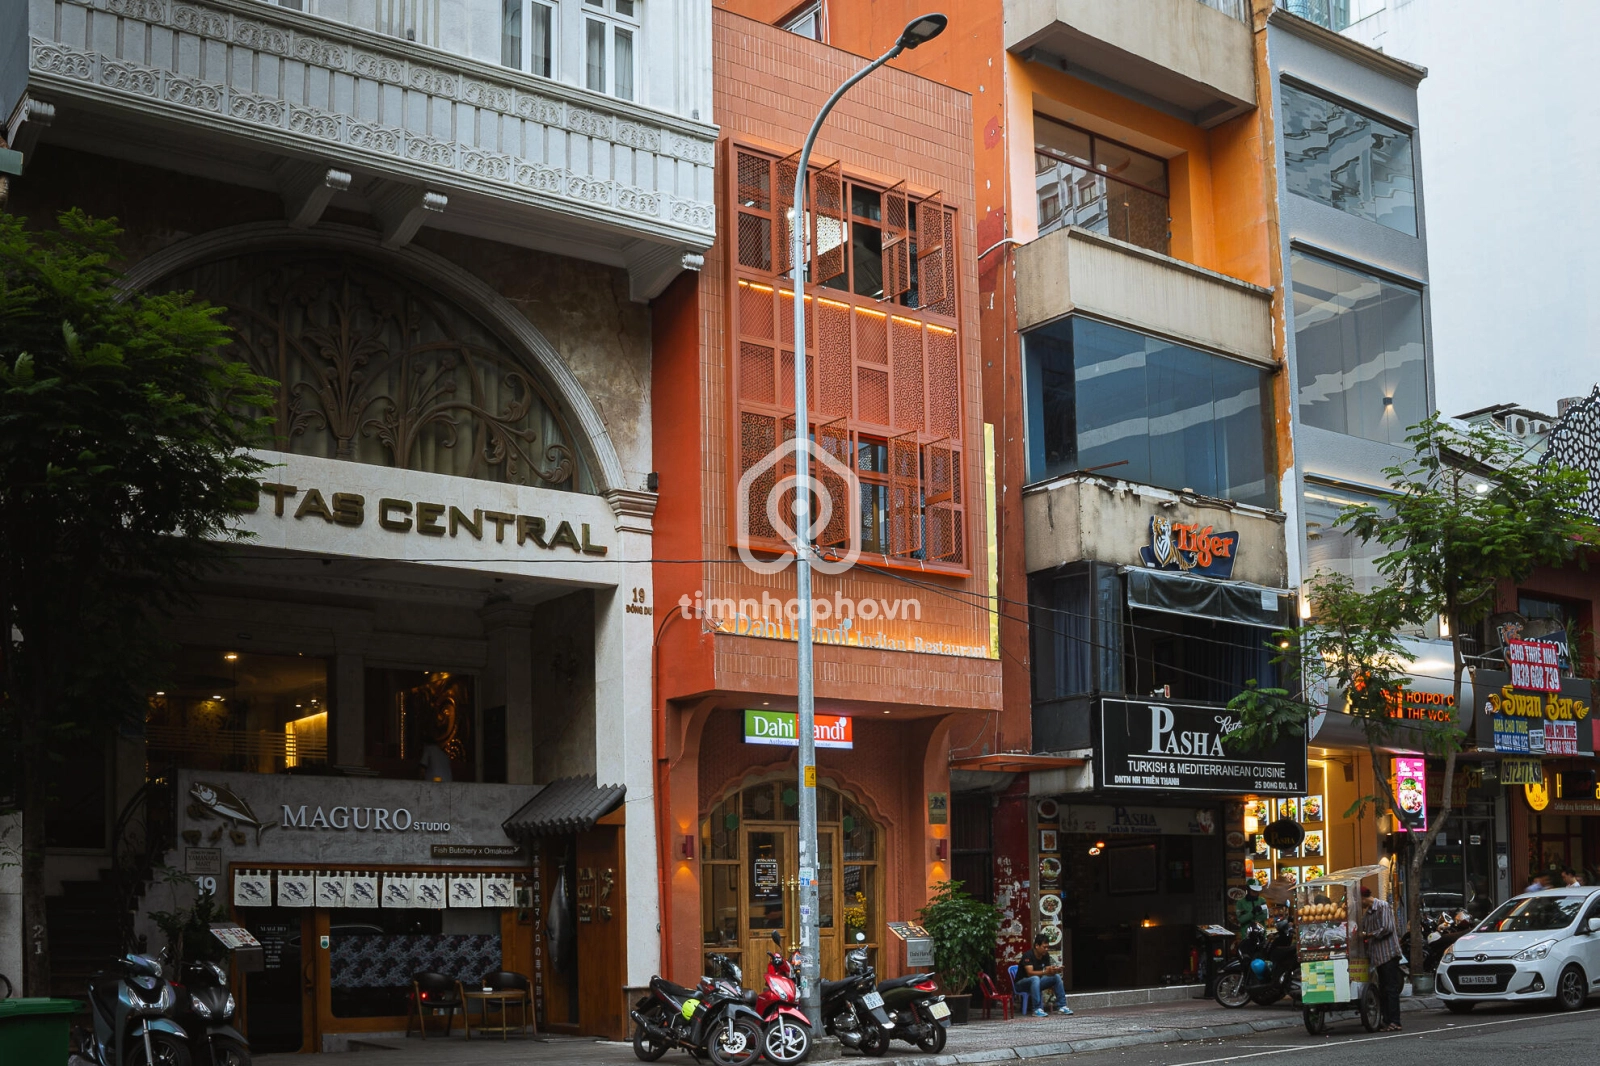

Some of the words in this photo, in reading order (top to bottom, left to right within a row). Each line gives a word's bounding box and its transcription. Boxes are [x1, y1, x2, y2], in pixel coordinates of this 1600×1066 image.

[378, 498, 608, 555] CENTRAL
[1172, 522, 1234, 567] Tiger
[633, 587, 645, 603] 19
[734, 612, 783, 640] Dahi
[791, 618, 852, 646] andi
[857, 632, 907, 652] Indian
[914, 636, 986, 659] Restaurant
[1510, 643, 1524, 661] CHO
[1406, 691, 1445, 706] HOTPOT
[1502, 685, 1542, 718] Swan
[1545, 692, 1572, 720] Bar
[1406, 708, 1426, 720] THE
[1427, 709, 1451, 722] WOK
[753, 716, 794, 737] Dahi
[797, 717, 847, 740] andi
[1147, 705, 1226, 757] PASHA
[1505, 719, 1515, 733] CHO
[1127, 760, 1167, 773] TURKISH
[1168, 762, 1176, 774] &
[1177, 763, 1251, 777] MEDITERRANEAN
[1252, 766, 1286, 779] CUISINE
[1254, 780, 1262, 789] 25
[281, 804, 412, 831] MAGURO
[413, 821, 451, 832] STUDIO
[1114, 806, 1157, 827] PASHA
[433, 846, 448, 854] Fish
[449, 846, 478, 856] Butchery
[484, 847, 514, 856] Omakase
[195, 876, 217, 896] 19
